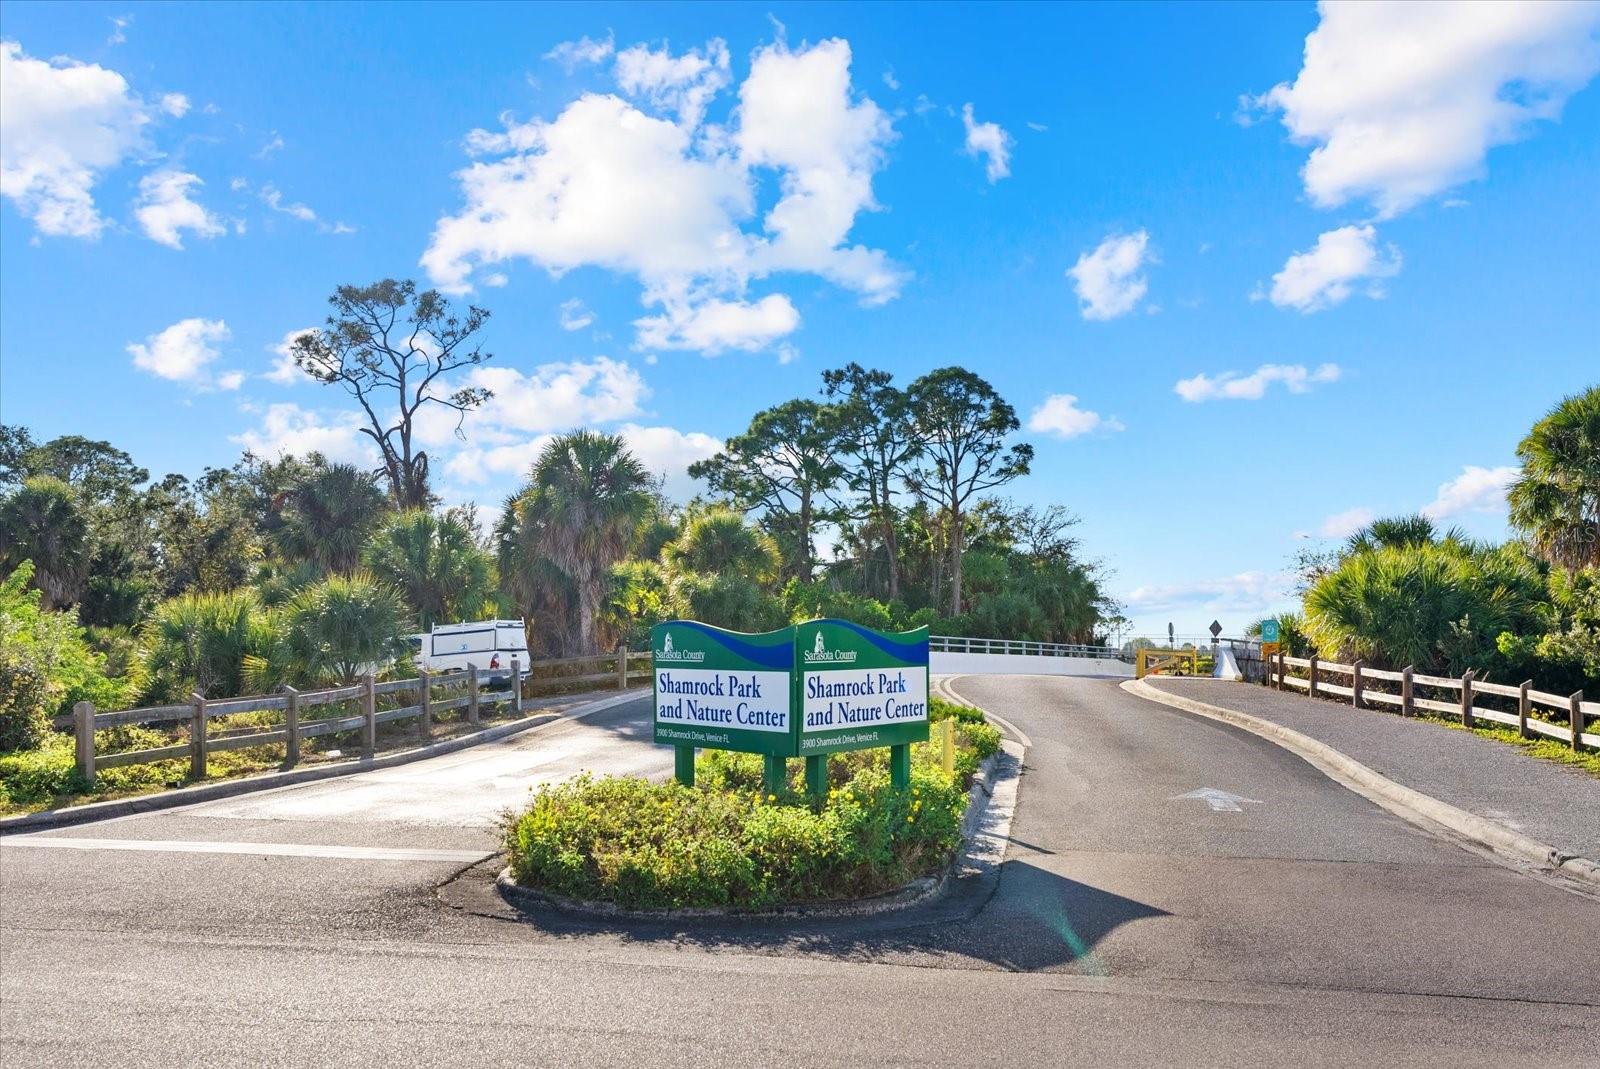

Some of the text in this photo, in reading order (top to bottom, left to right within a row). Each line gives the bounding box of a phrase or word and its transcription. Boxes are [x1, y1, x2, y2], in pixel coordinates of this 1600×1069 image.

[655, 649, 705, 660] Sarasota County
[805, 649, 857, 660] Sarasota County
[659, 672, 761, 698] Shamrock Park
[807, 672, 906, 699] Shamrock Park
[660, 698, 786, 727] and Nature Center
[807, 698, 924, 726] and Nature Center
[656, 728, 730, 743] 3900 Shamrock Drive, Venice FL
[802, 731, 879, 749] 3900 Shamrock Drive, Venice FL
